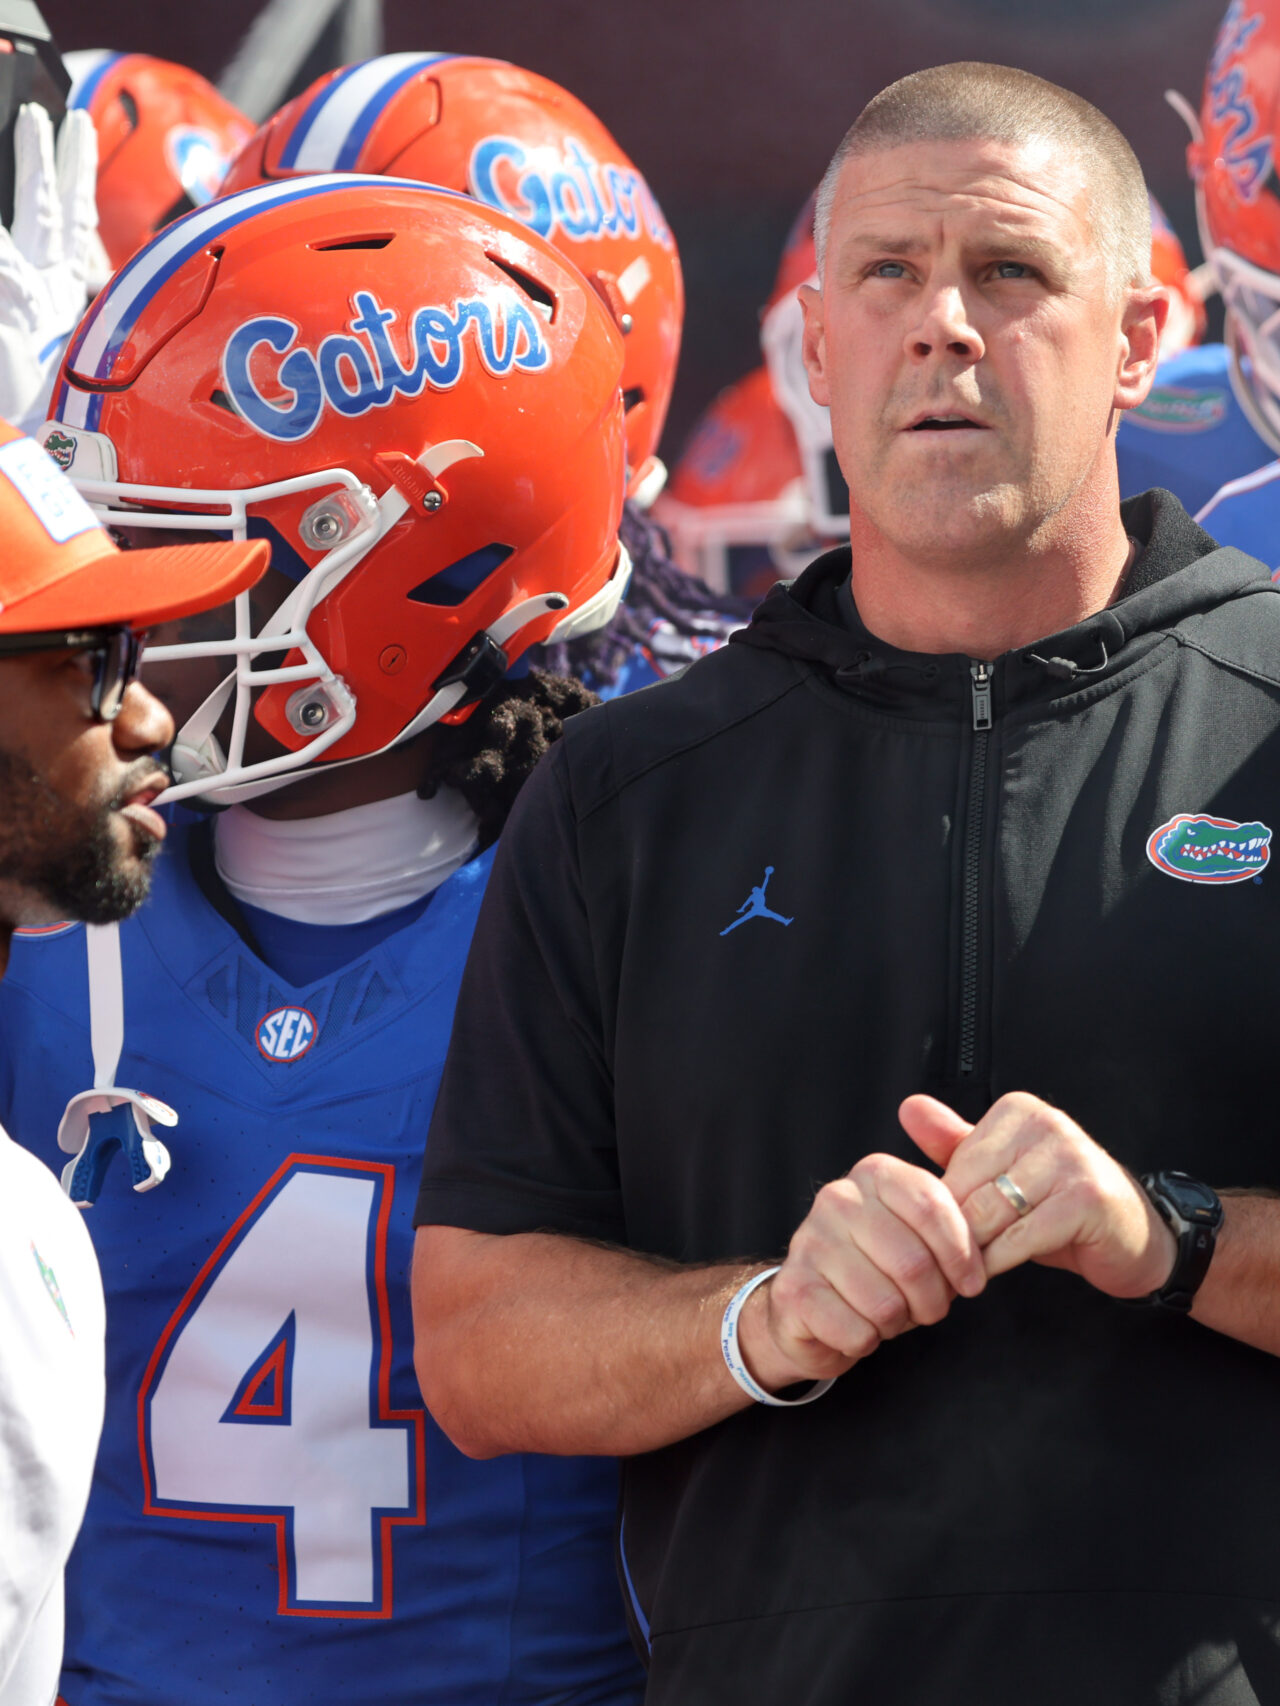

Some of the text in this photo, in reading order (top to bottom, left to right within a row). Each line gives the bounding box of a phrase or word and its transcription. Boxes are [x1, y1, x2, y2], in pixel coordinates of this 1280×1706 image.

[470, 135, 675, 249] Gator
[222, 290, 551, 442] Gators
[260, 1008, 313, 1058] SEC
[137, 1153, 426, 1619] 4
